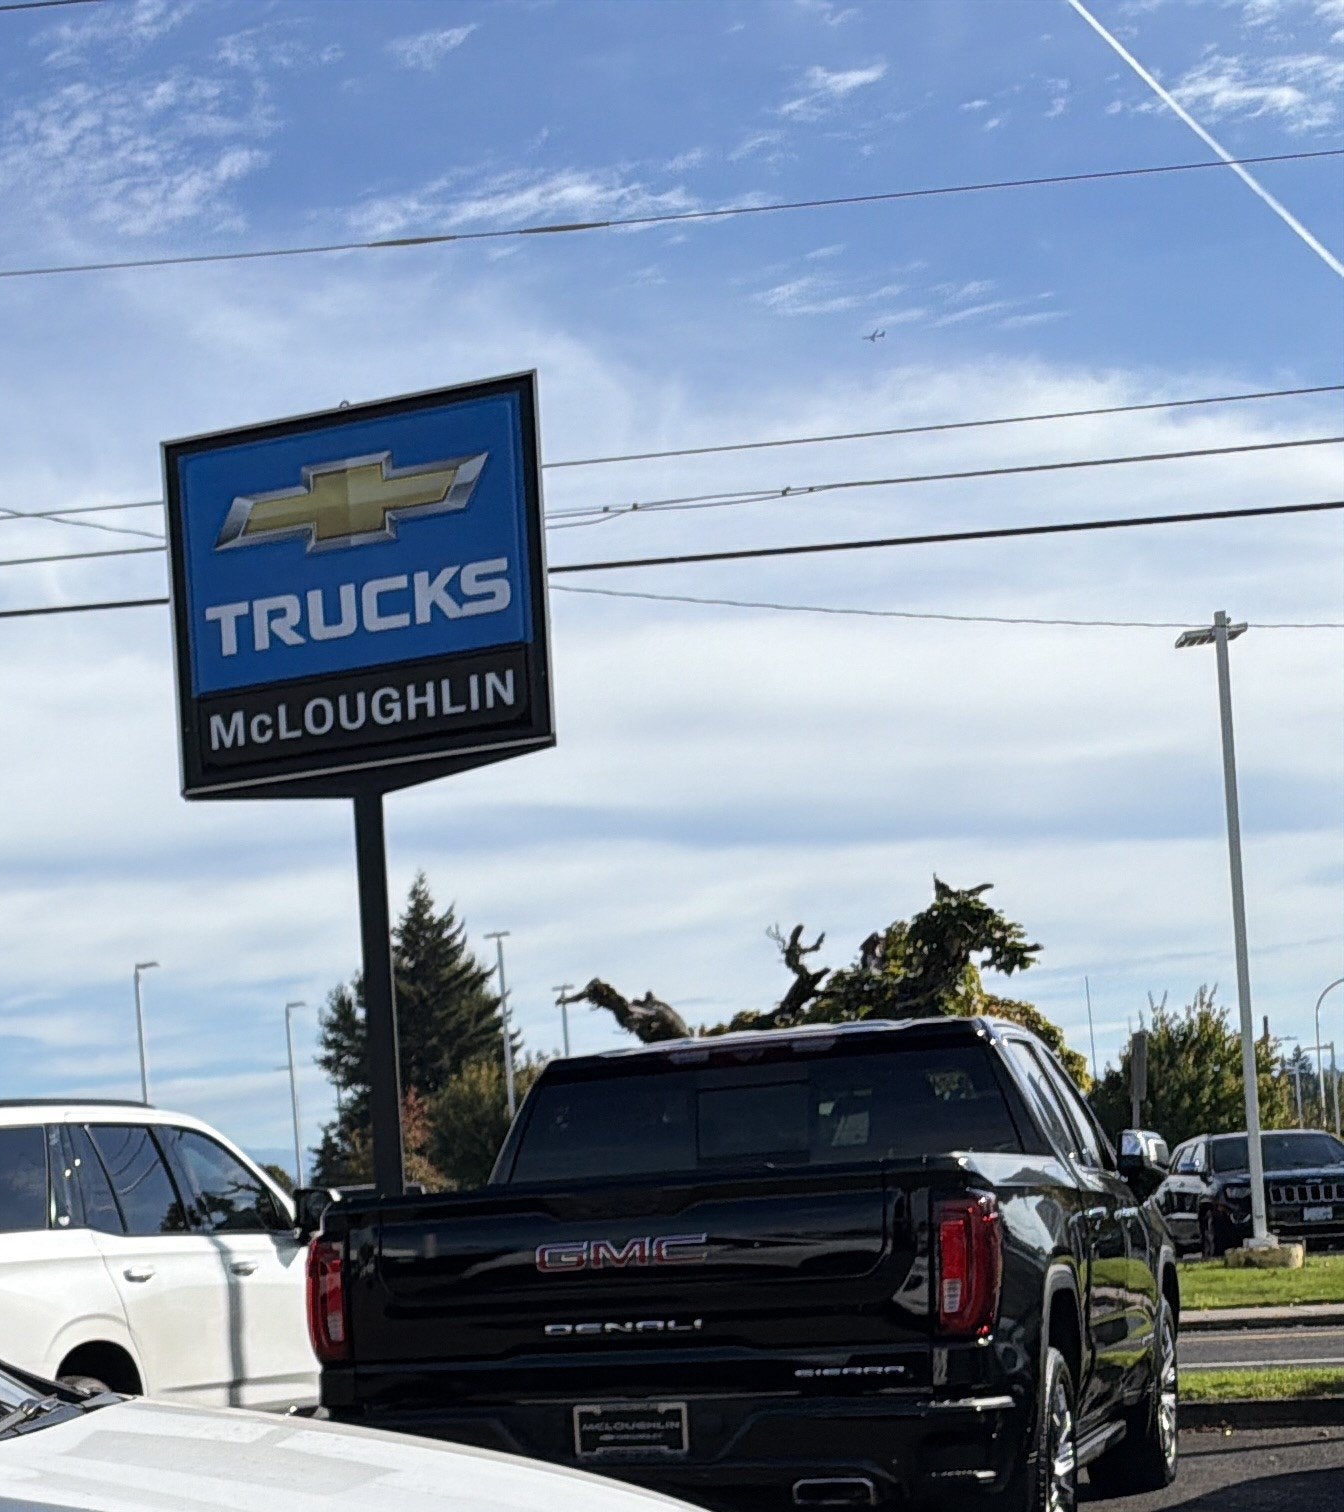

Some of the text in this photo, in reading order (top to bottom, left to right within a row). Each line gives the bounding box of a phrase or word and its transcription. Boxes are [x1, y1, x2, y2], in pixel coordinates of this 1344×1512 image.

[206, 556, 512, 657] TRUCKS
[209, 668, 516, 751] McLOUGHLIN
[535, 1232, 708, 1273] GMC
[544, 1317, 703, 1336] DENALI
